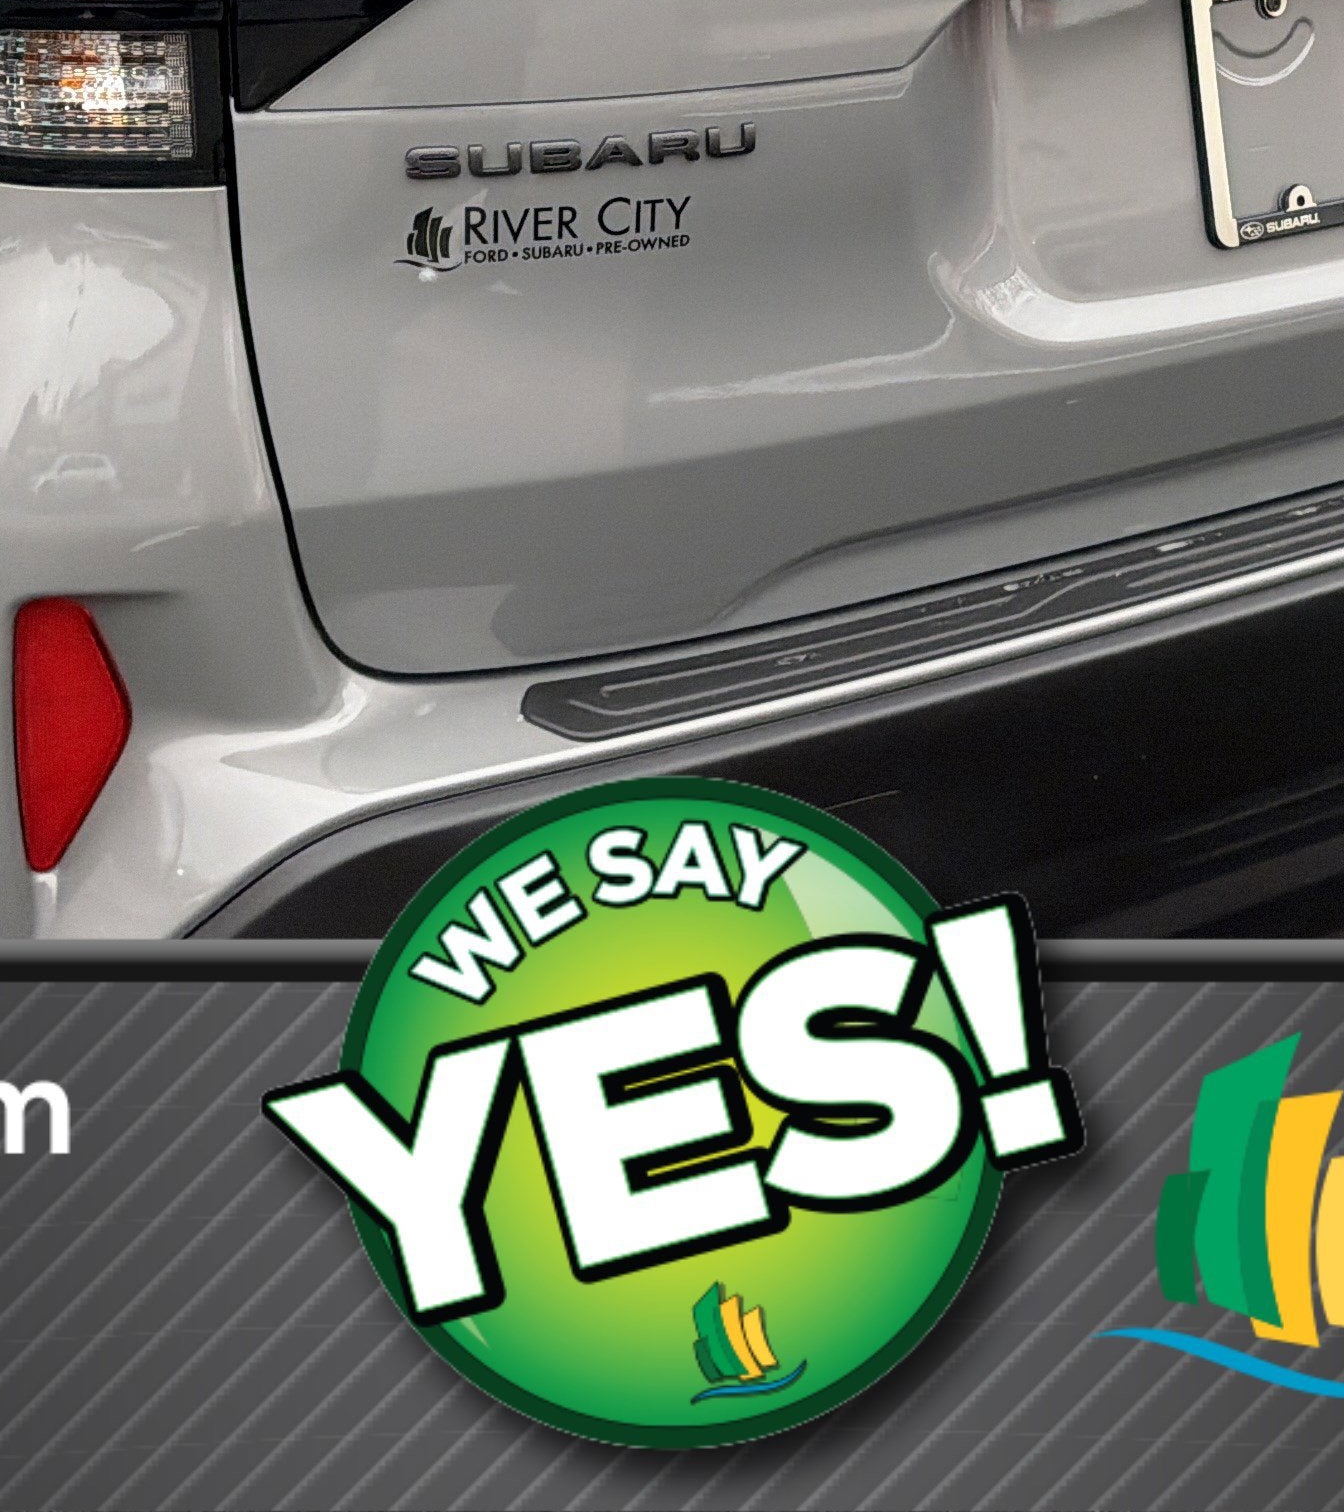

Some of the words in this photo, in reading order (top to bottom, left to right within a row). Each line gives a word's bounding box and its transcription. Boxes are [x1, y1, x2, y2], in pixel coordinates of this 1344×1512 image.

[405, 121, 757, 179] SUBARU
[464, 205, 578, 246] RIVER
[597, 195, 692, 236] CITY
[1266, 213, 1320, 234] SUBARU
[464, 248, 509, 264] FORD
[521, 242, 585, 261] SUBARU
[595, 234, 691, 253] PRE-OWNED
